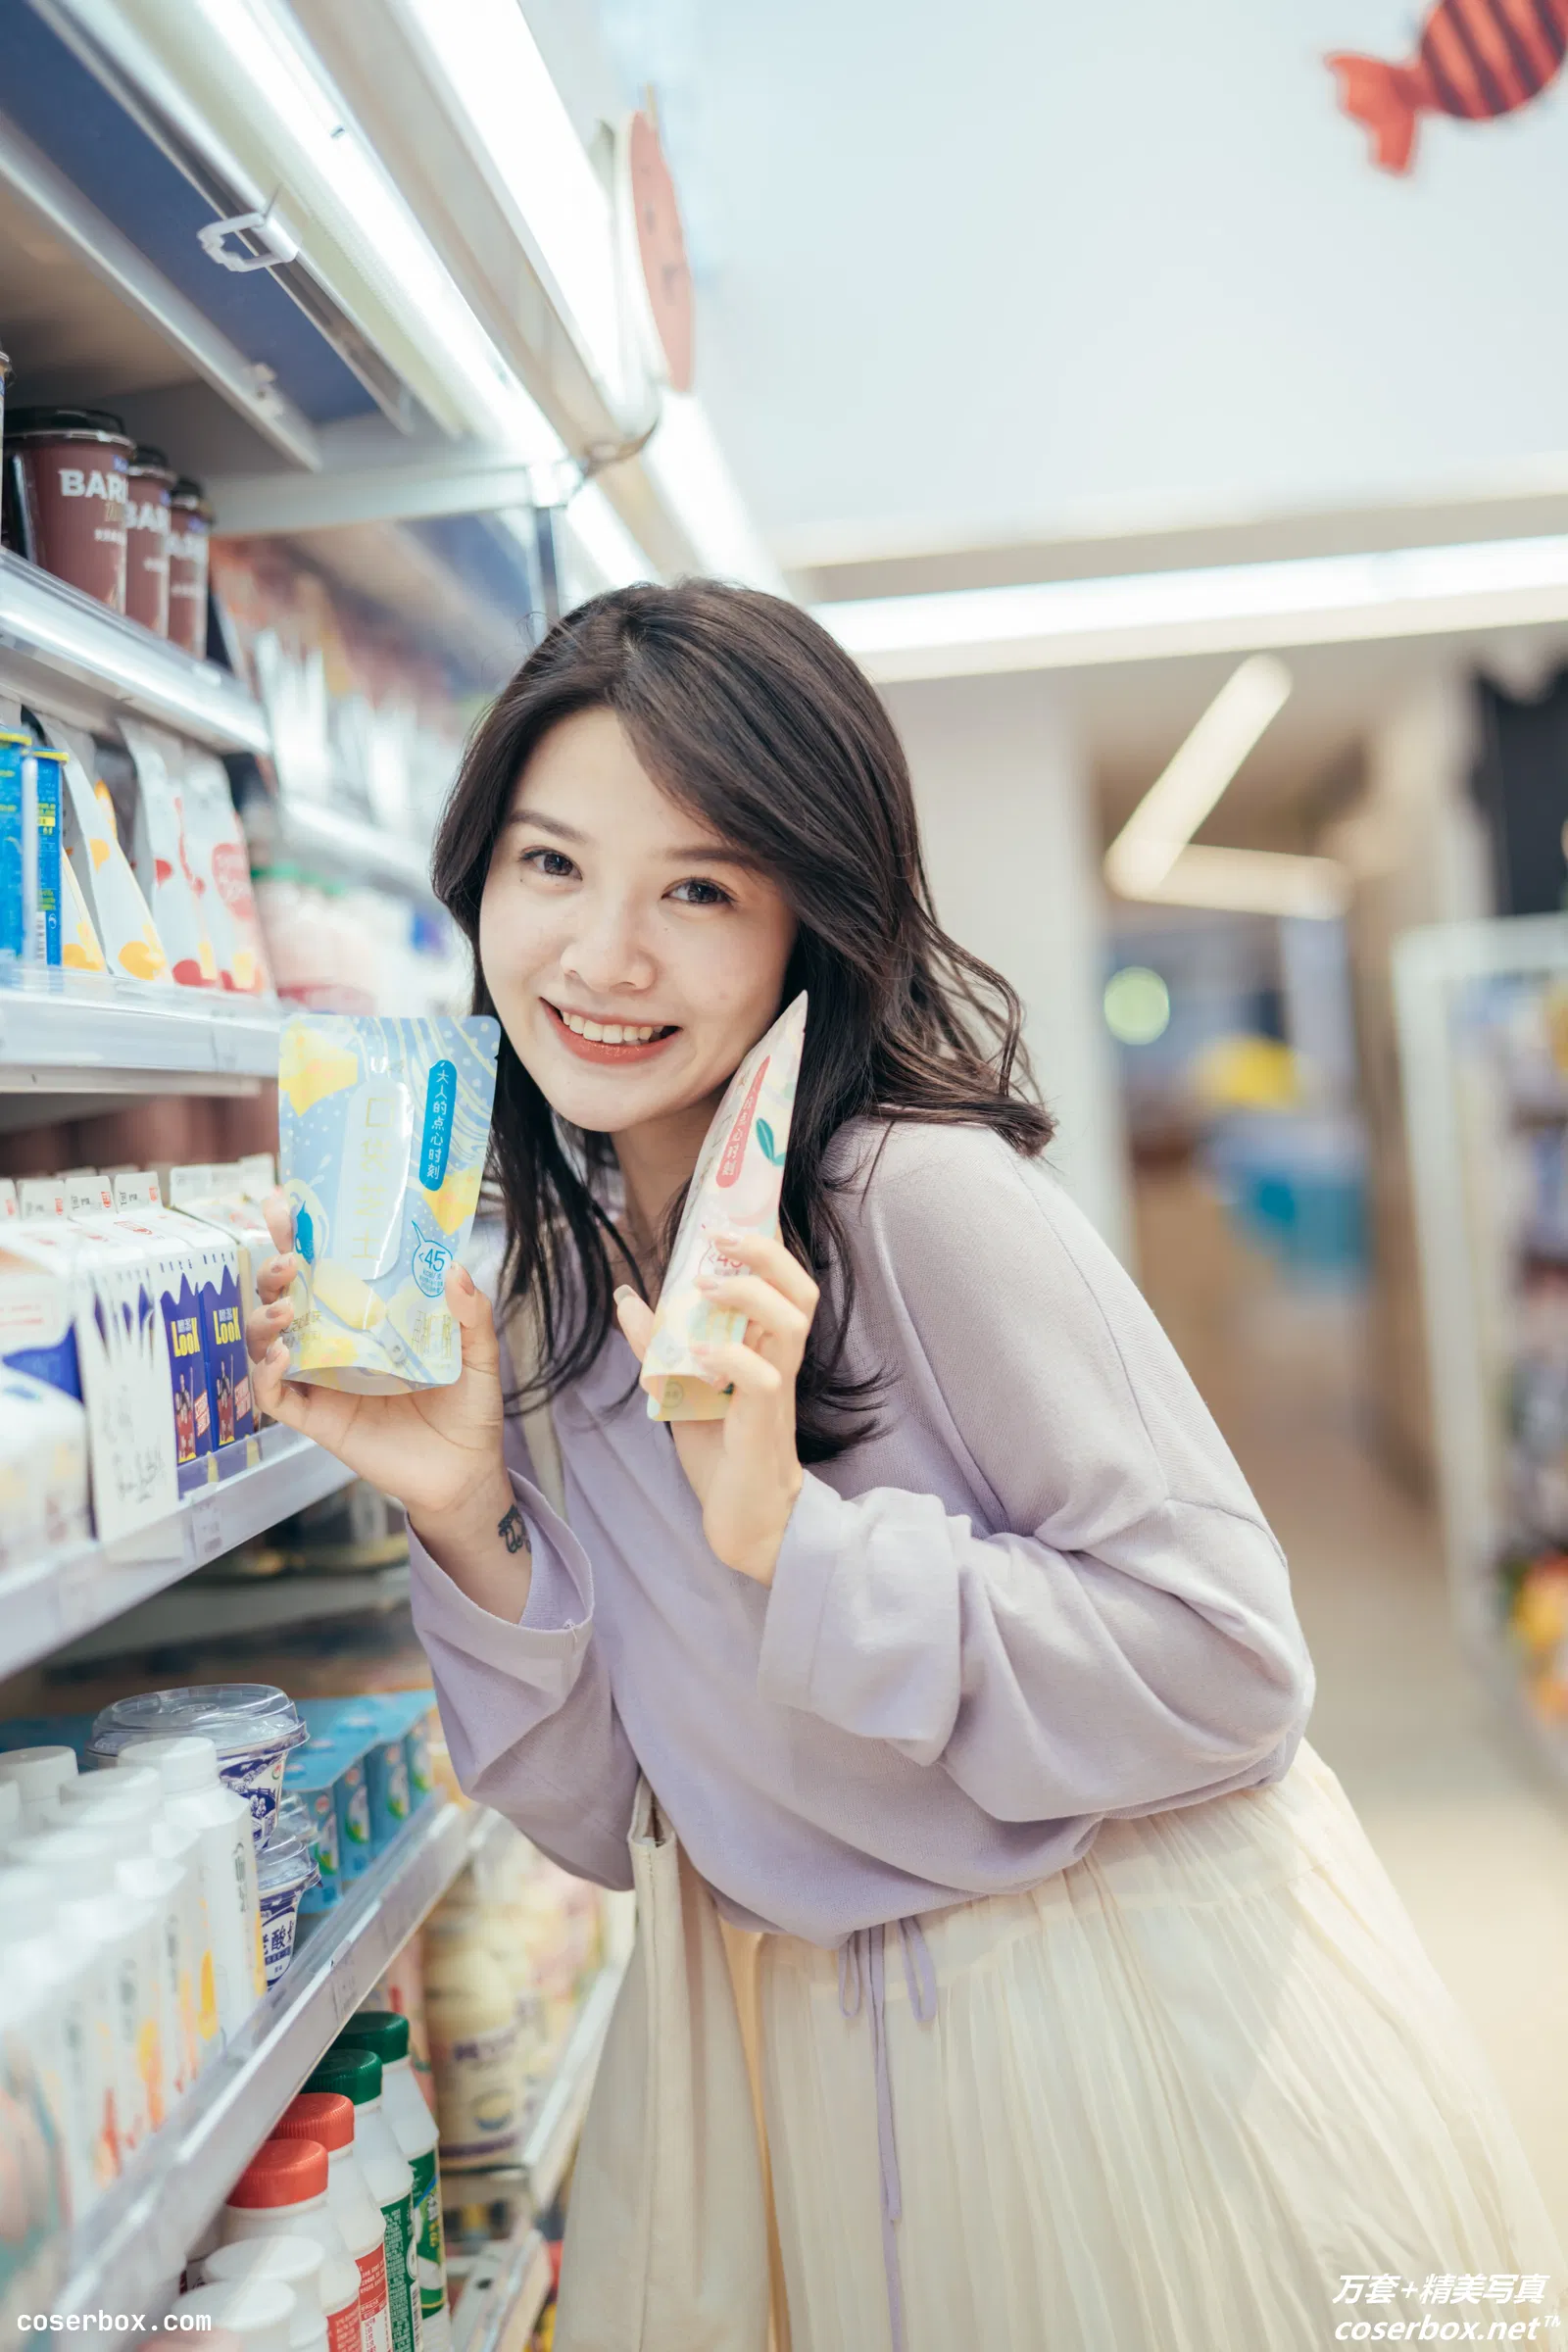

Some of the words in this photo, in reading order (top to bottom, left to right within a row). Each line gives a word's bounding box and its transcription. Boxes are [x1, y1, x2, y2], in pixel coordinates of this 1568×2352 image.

[351, 1097, 396, 1260] 口袋芝士
[426, 1069, 450, 1181] 大人的点心时刻
